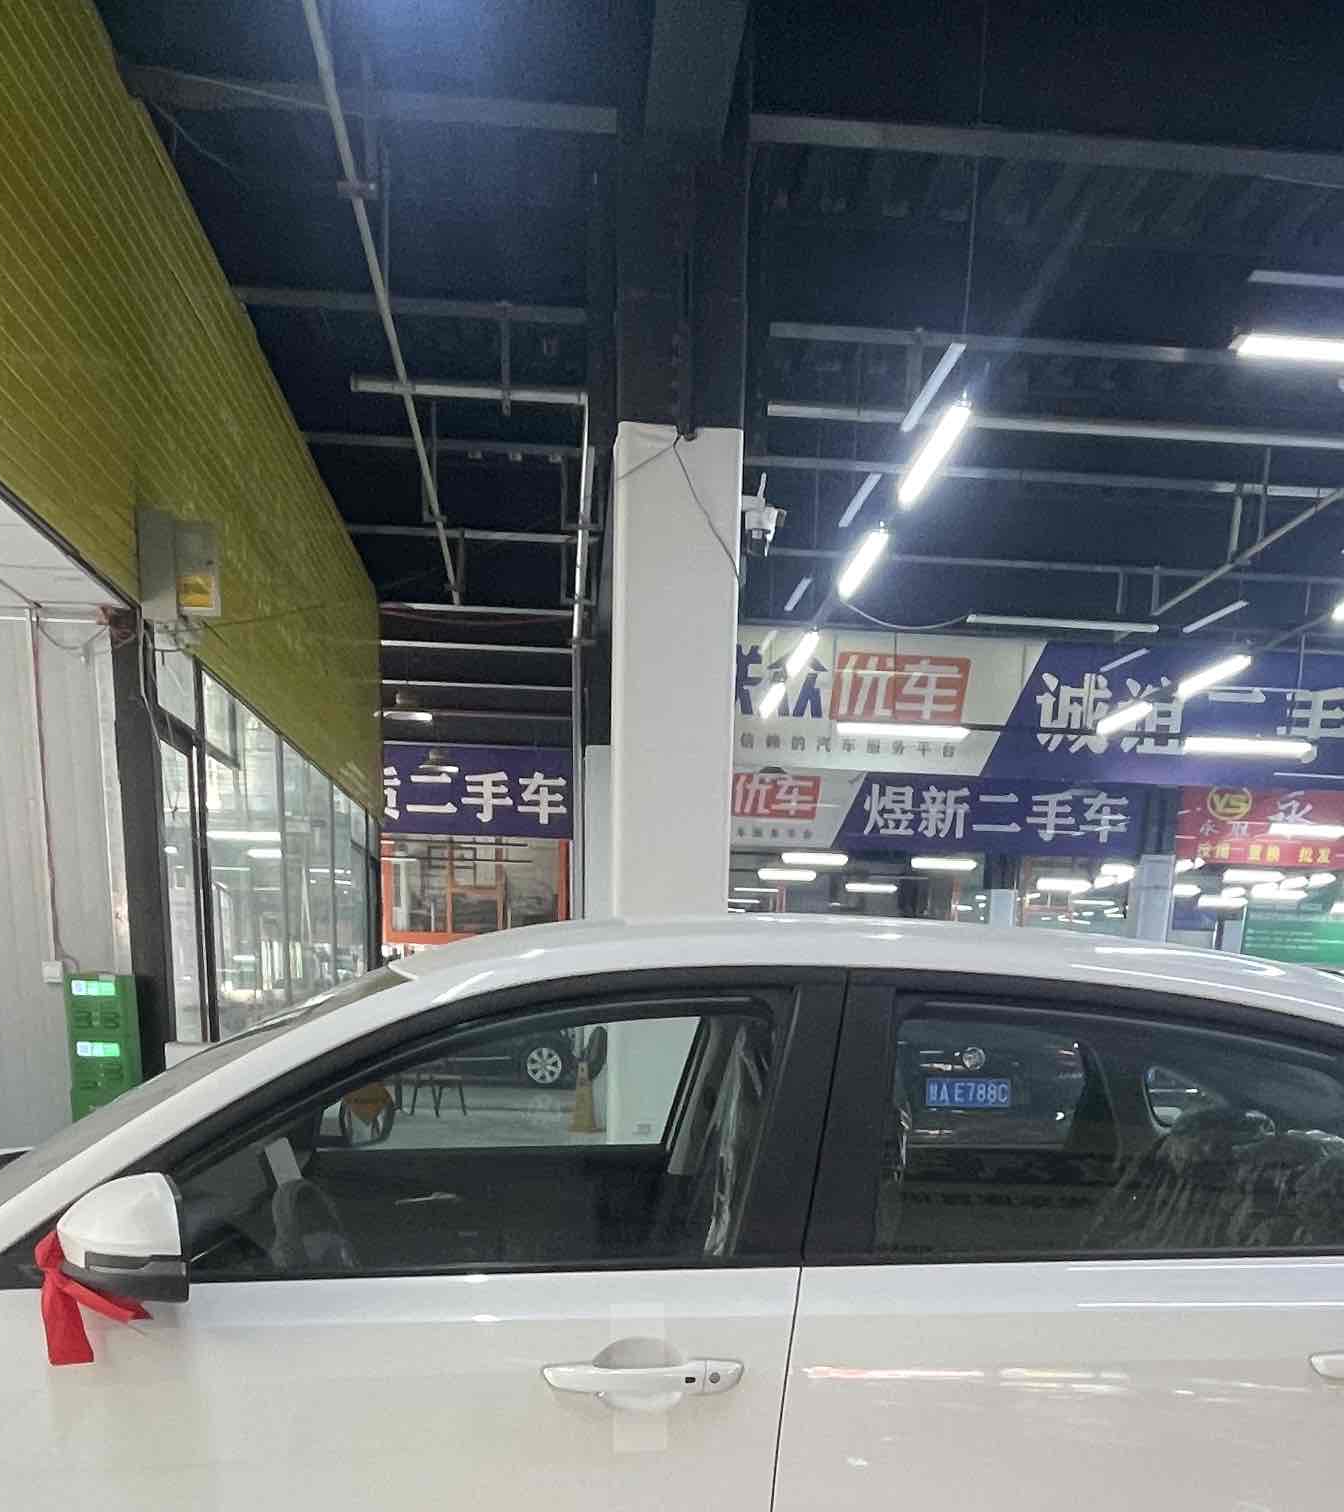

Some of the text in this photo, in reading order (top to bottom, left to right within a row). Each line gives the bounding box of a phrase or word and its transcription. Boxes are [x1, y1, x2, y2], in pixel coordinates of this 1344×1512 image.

[863, 782, 1130, 843] 煜新二手车
